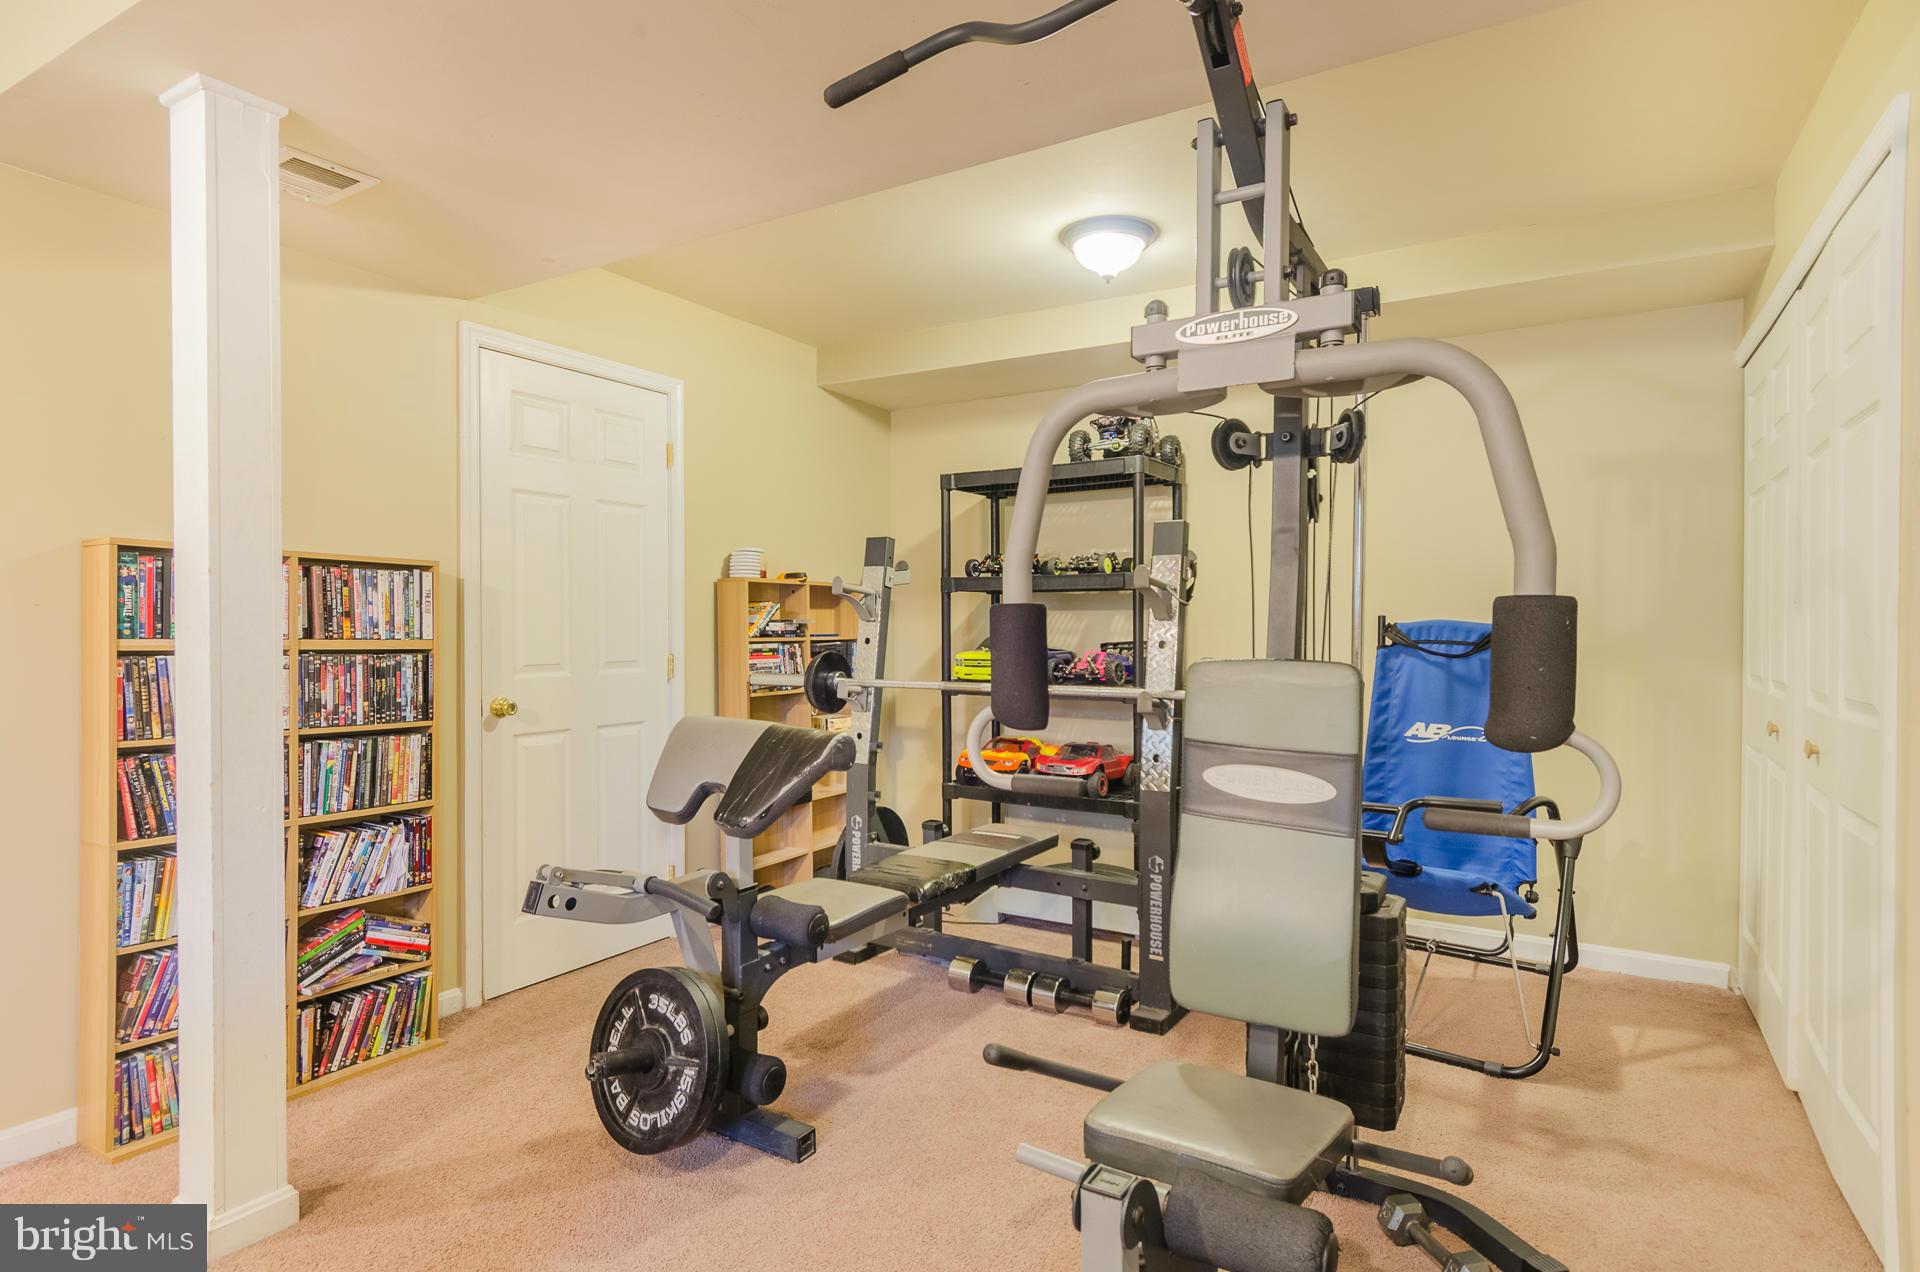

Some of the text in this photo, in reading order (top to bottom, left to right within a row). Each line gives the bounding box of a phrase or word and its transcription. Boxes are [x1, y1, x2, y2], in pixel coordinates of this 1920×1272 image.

[1186, 310, 1290, 337] Powerhouse
[1216, 331, 1254, 341] ELITE
[1404, 722, 1452, 738] AB
[852, 831, 861, 871] POWERH
[1150, 873, 1163, 956] POWERHOUSE
